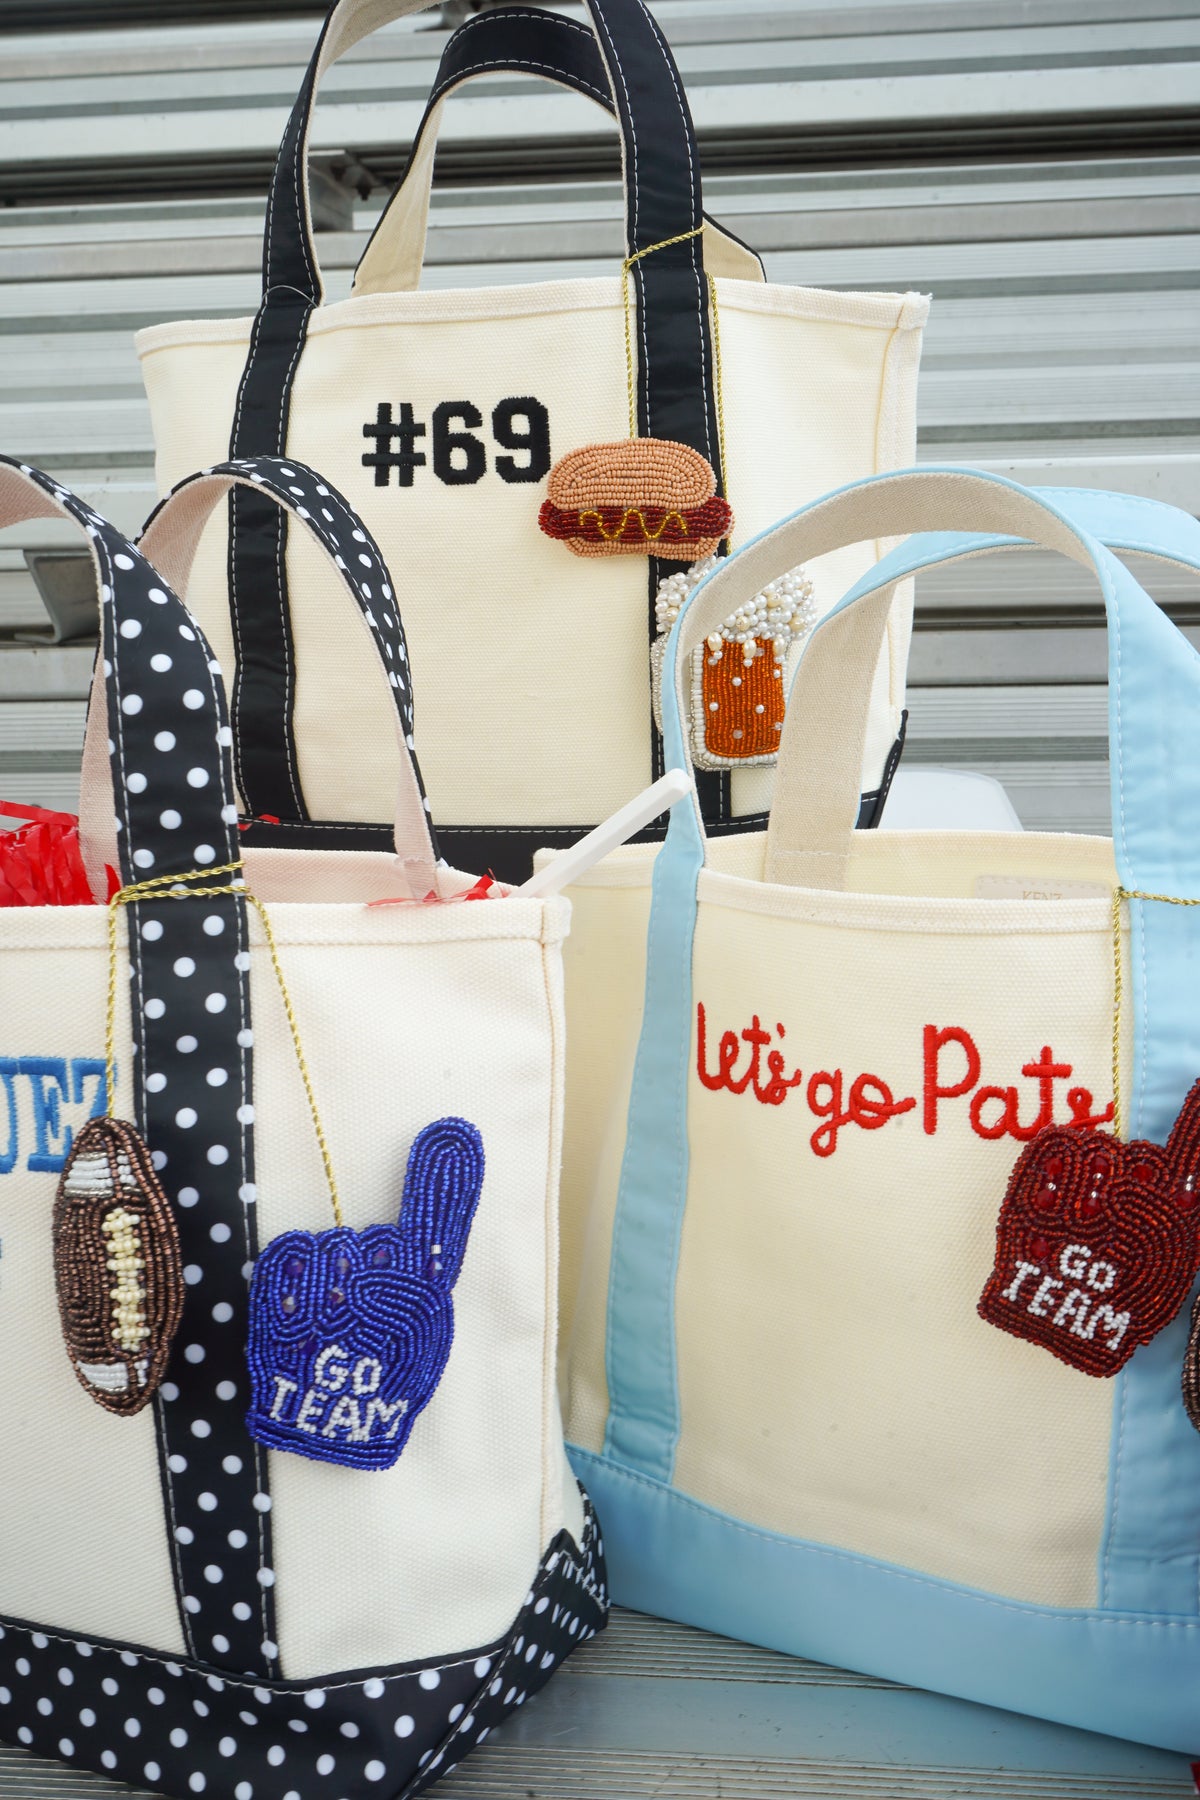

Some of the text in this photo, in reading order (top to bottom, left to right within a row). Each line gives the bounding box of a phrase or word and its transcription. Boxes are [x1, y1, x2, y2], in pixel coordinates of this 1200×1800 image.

[362, 396, 550, 487] #69
[807, 1069, 916, 1157] go
[924, 1025, 1116, 1141] Pats
[1001, 1260, 1131, 1351] TEAM
[1059, 1244, 1117, 1293] GO
[269, 1376, 409, 1443] TEAM
[314, 1344, 383, 1396] GO
